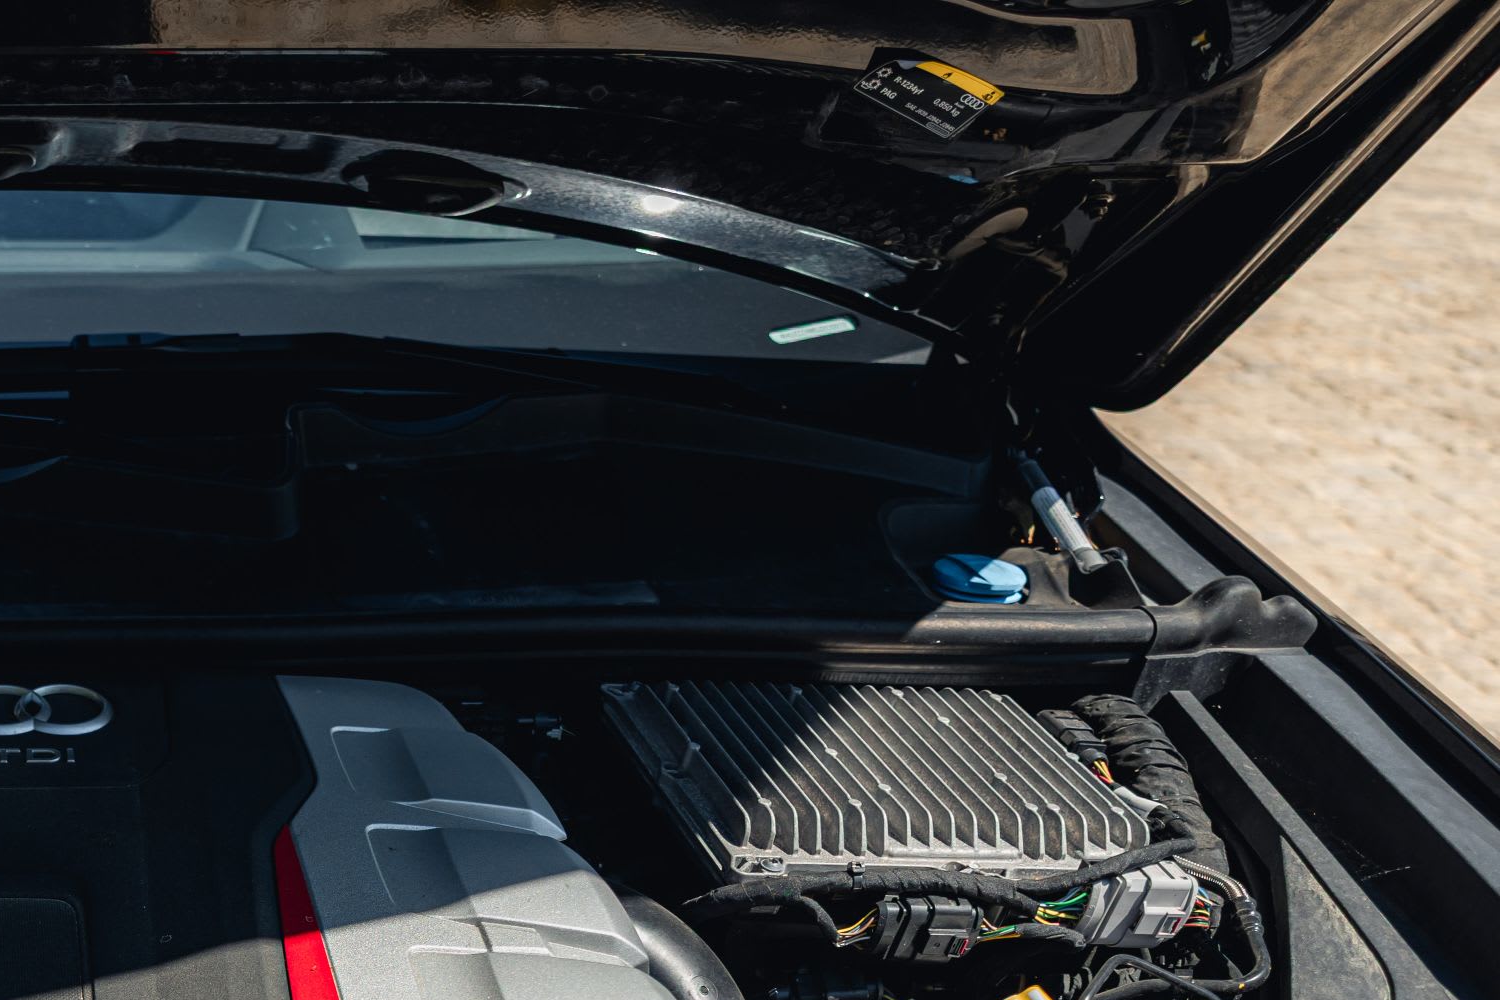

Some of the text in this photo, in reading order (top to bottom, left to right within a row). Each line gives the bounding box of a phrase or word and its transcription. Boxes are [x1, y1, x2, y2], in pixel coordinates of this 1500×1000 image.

[893, 76, 925, 95] R-1234yf
[880, 87, 897, 99] PAG
[950, 108, 960, 117] kg
